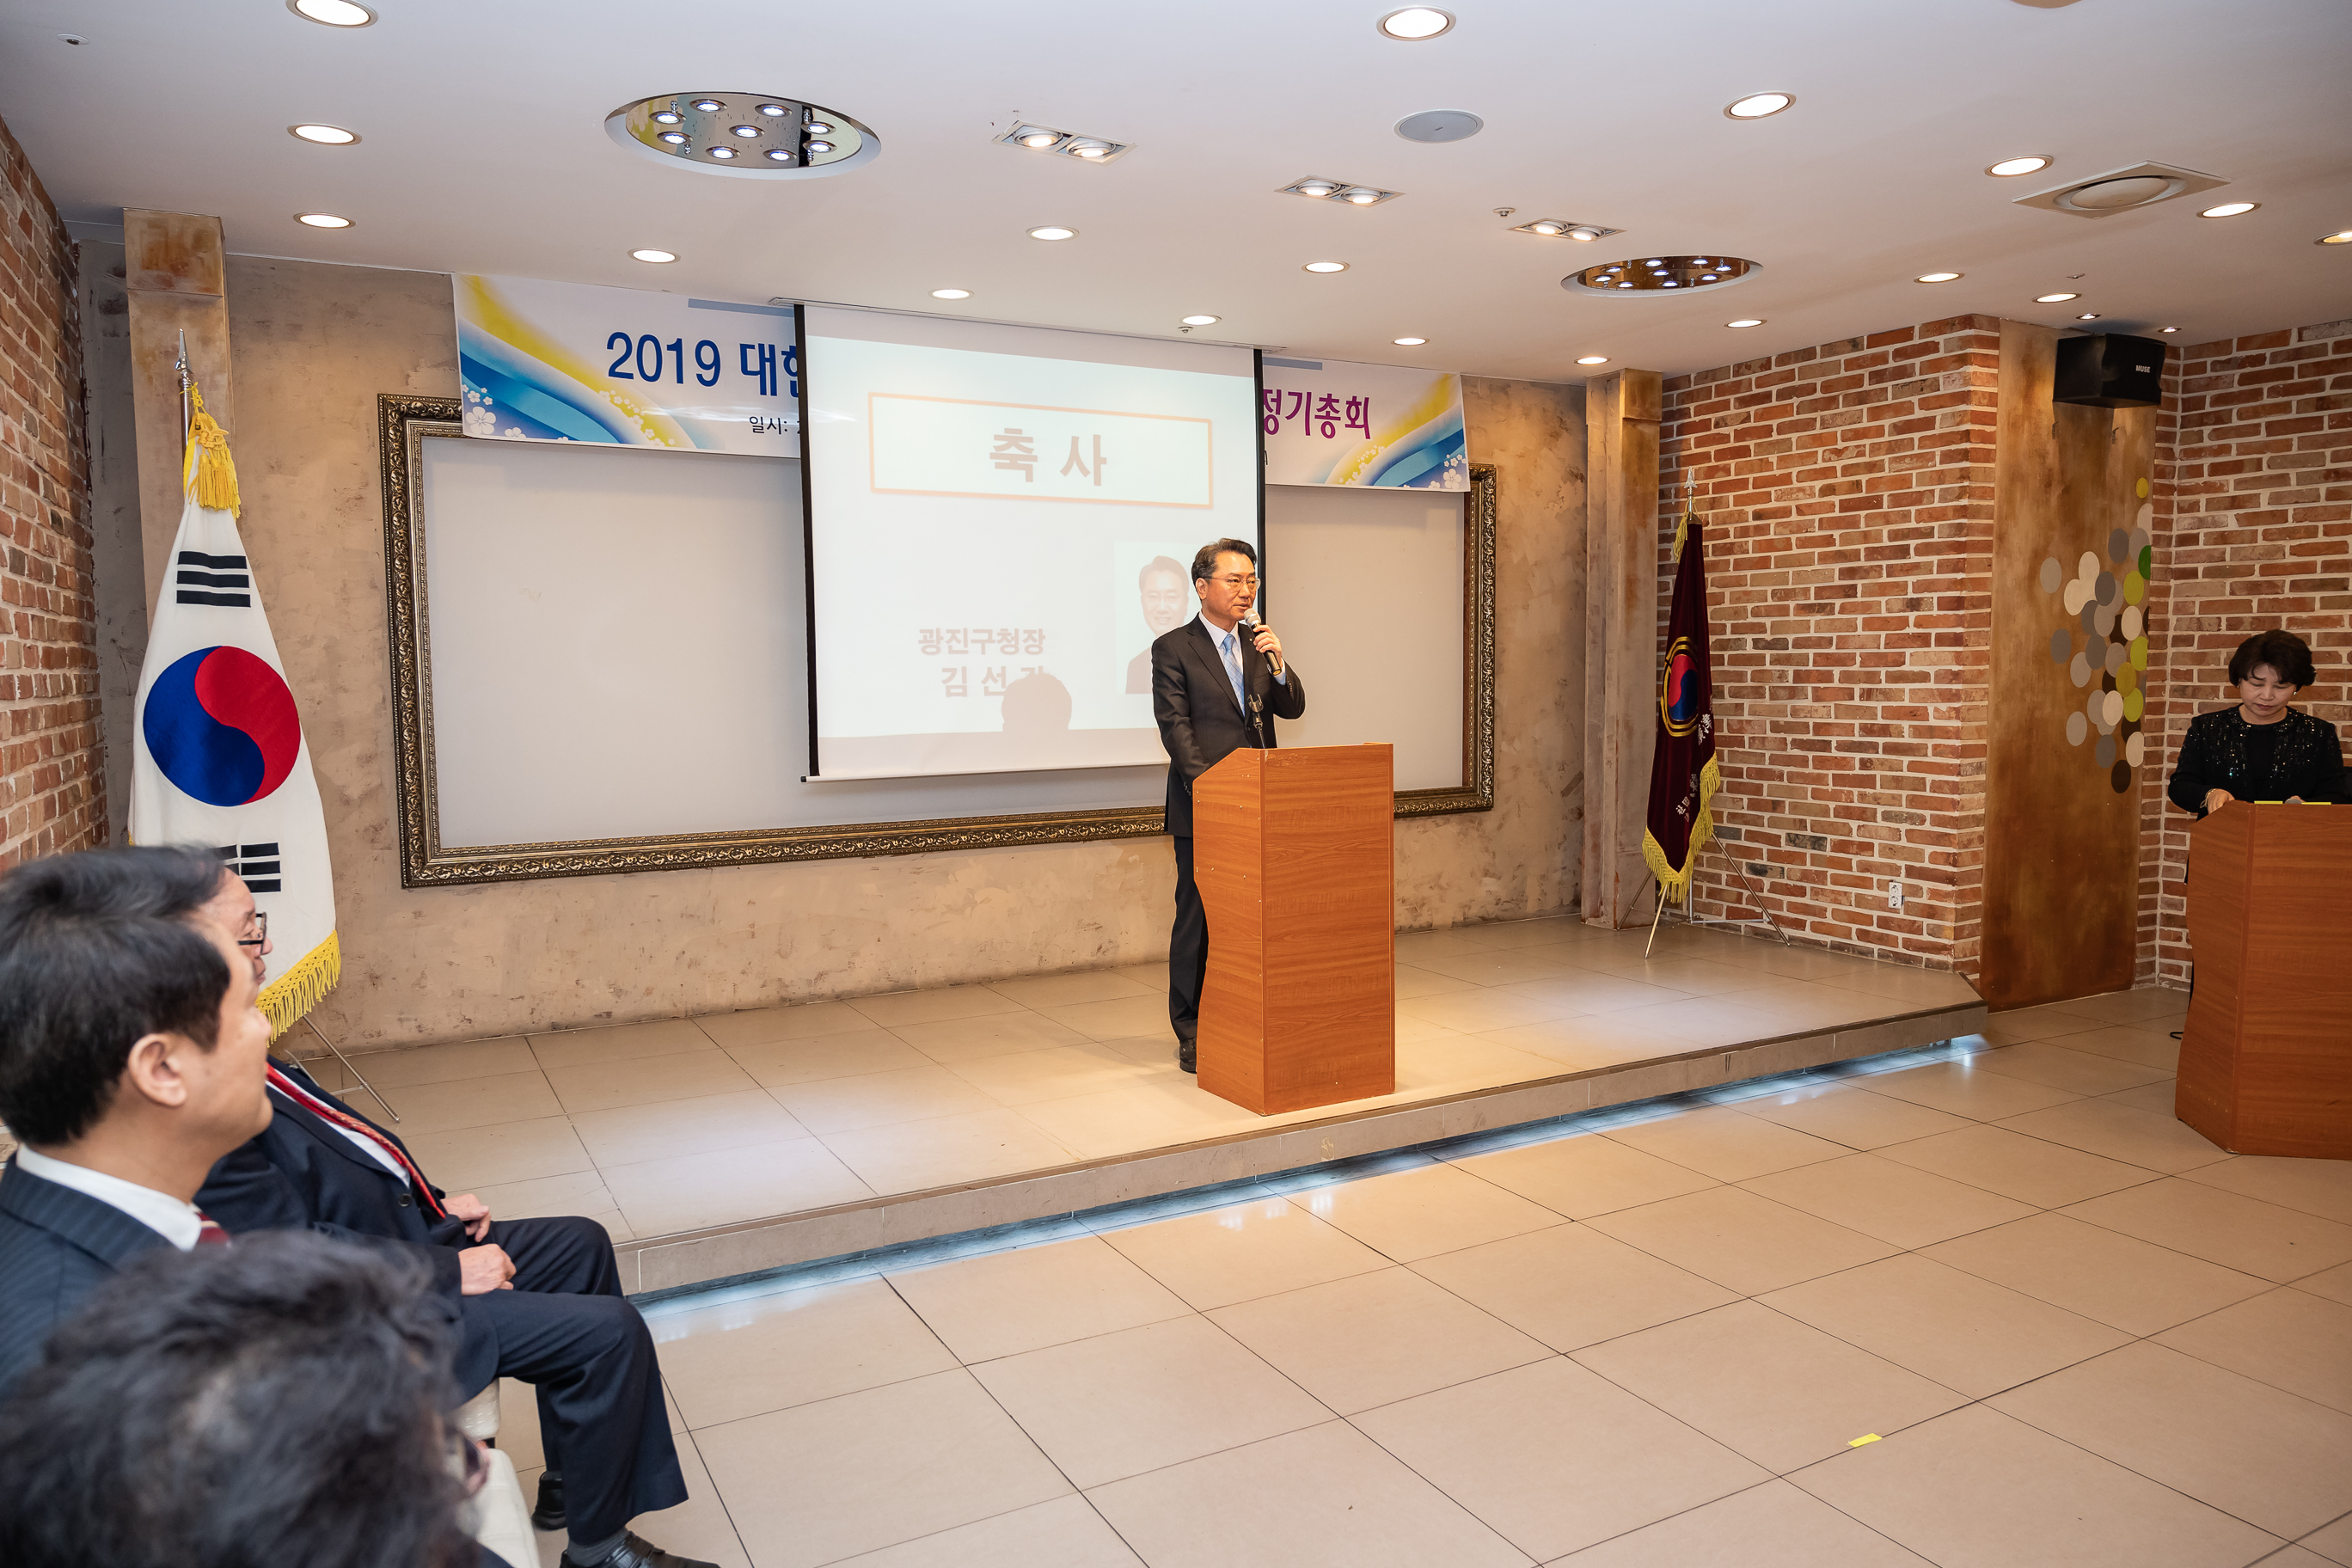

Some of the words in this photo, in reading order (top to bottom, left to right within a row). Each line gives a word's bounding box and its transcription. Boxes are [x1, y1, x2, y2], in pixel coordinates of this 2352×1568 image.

[607, 332, 720, 387] 2019
[2135, 364, 2150, 373] MUSE
[750, 416, 787, 434] 일시:
[1263, 389, 1371, 439] 정기총회
[989, 427, 1038, 482] 축
[1060, 434, 1106, 486] 사
[918, 628, 1045, 656] 광진구청장
[941, 666, 968, 697] 김
